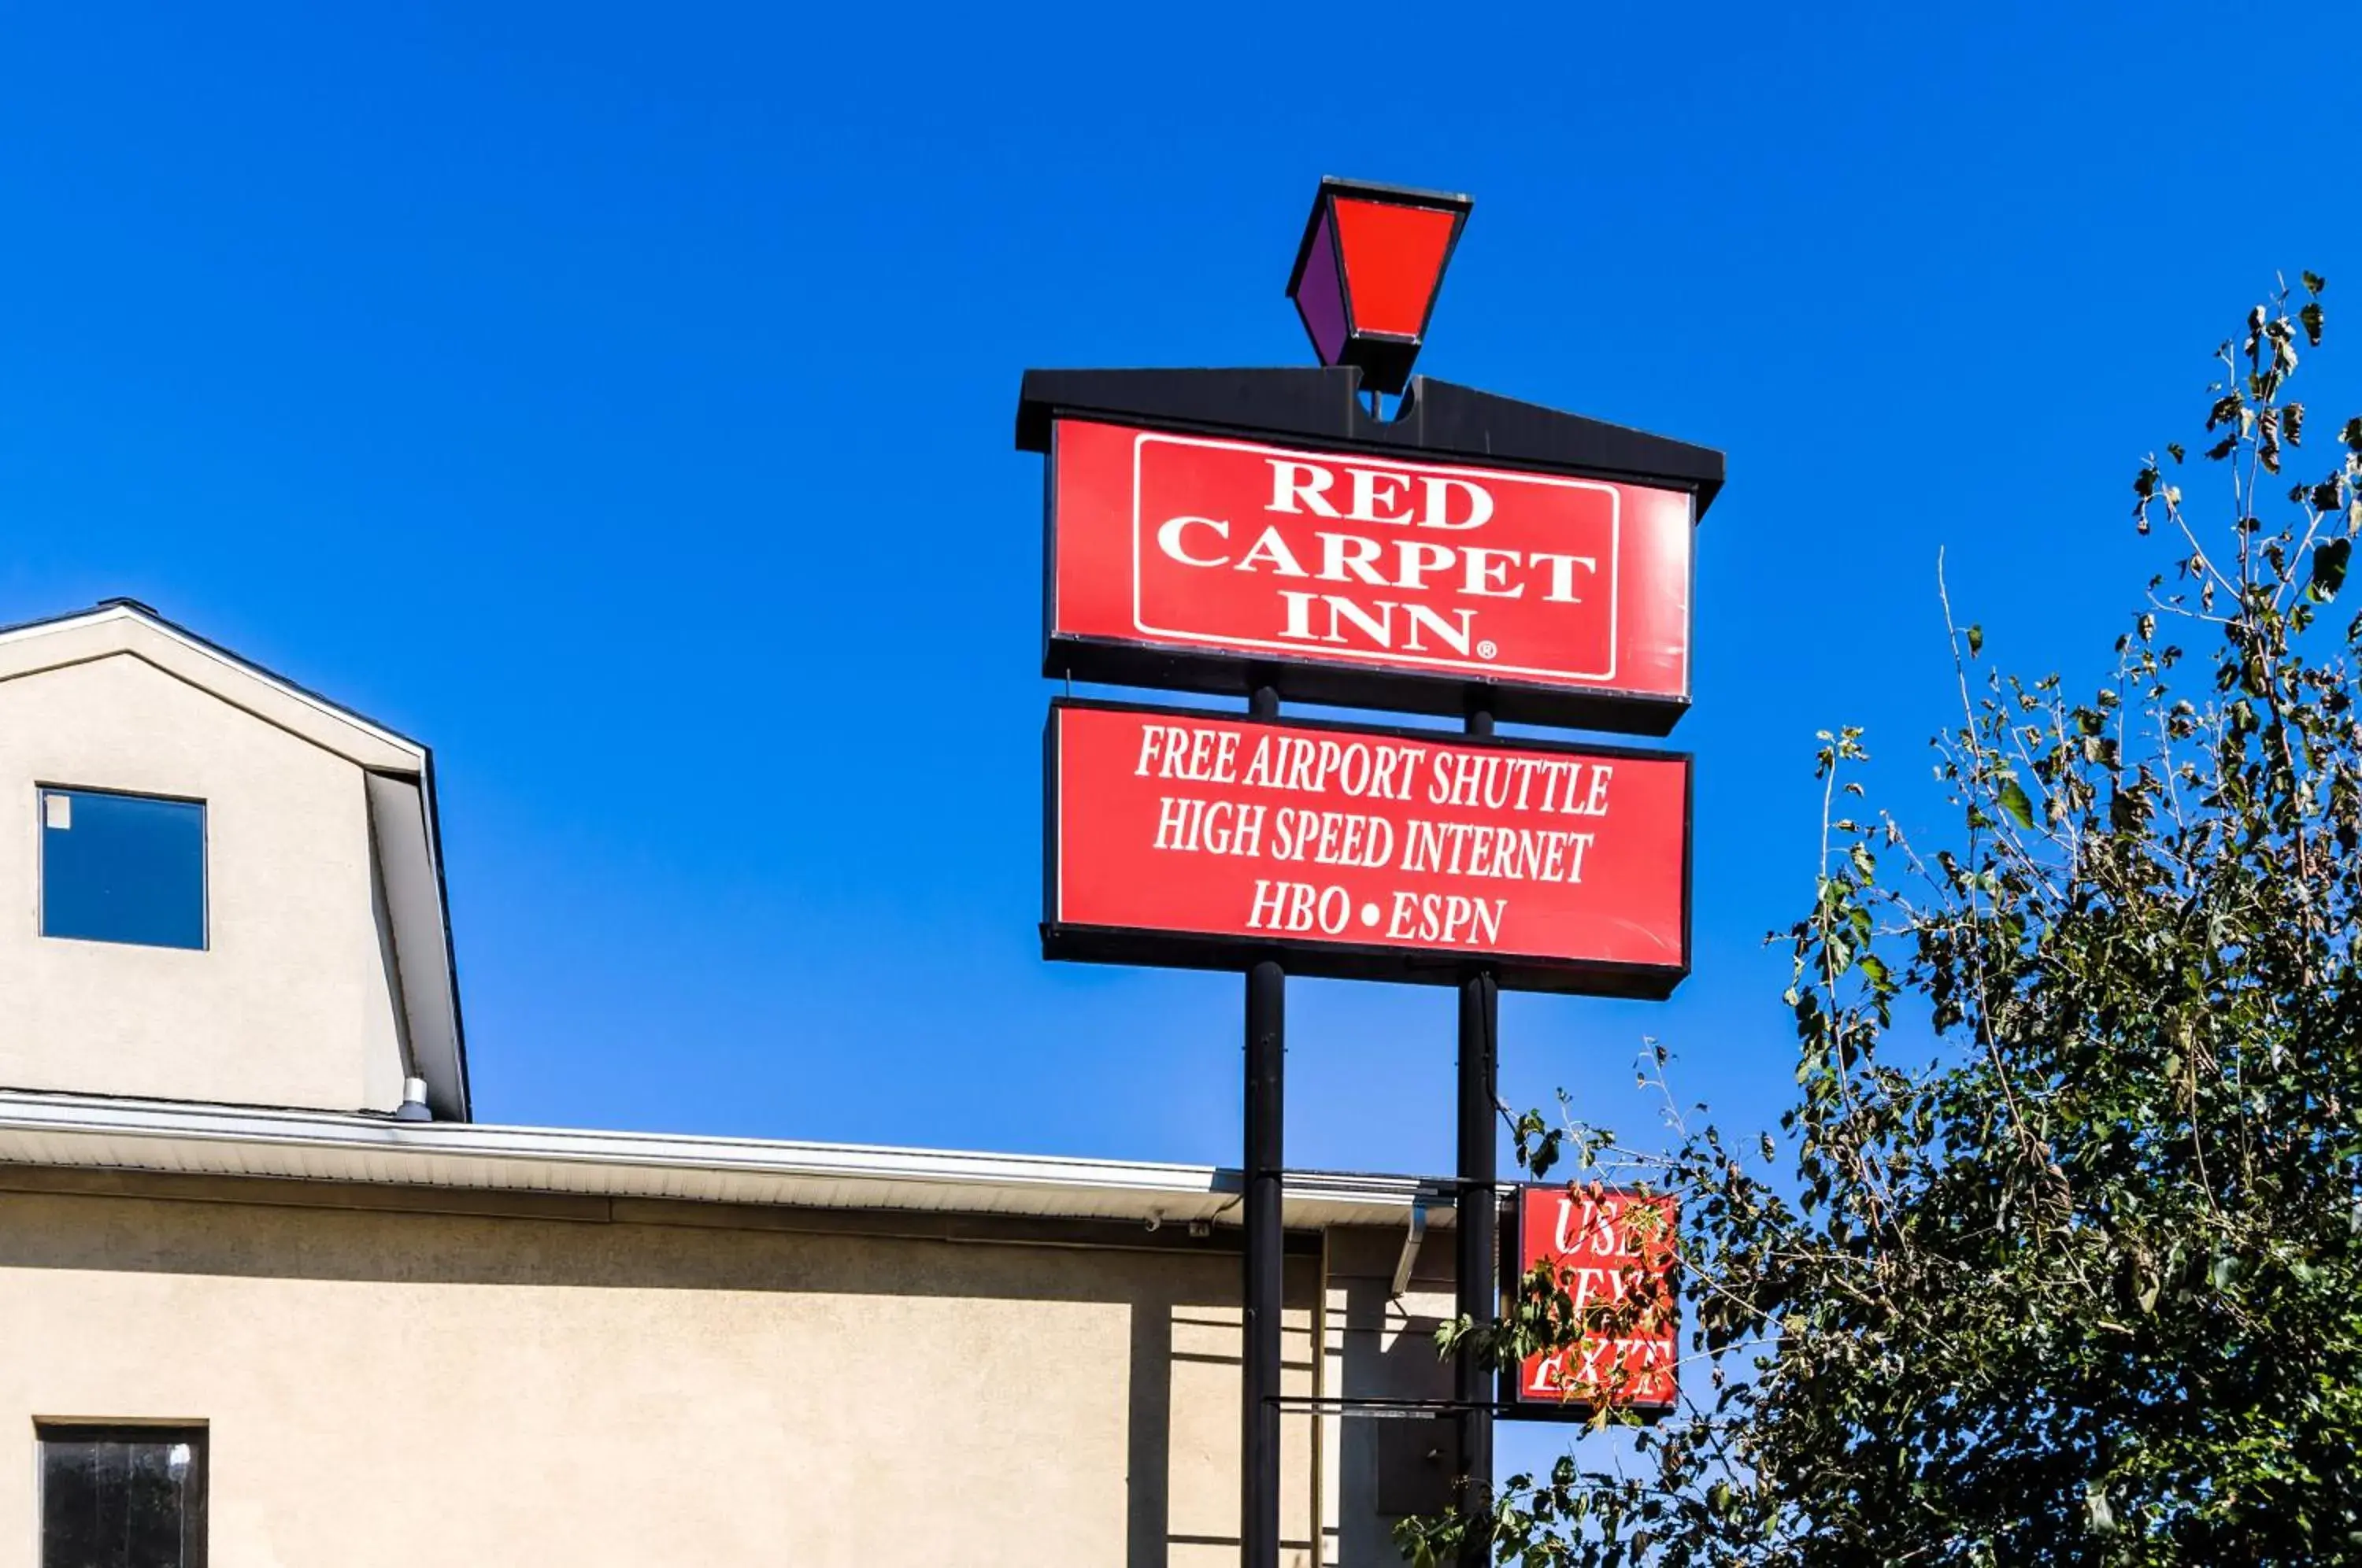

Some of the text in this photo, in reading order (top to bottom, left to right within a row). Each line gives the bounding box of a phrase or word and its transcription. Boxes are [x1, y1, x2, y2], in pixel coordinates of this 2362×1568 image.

[1264, 459, 1494, 530] RED
[1157, 516, 1596, 603] CARPET
[1134, 724, 1613, 816] FREE AIRPORT SHUTTLE
[1153, 797, 1594, 883] HIGH SPEED INTERNET
[1246, 879, 1508, 945] HBO ESPN
